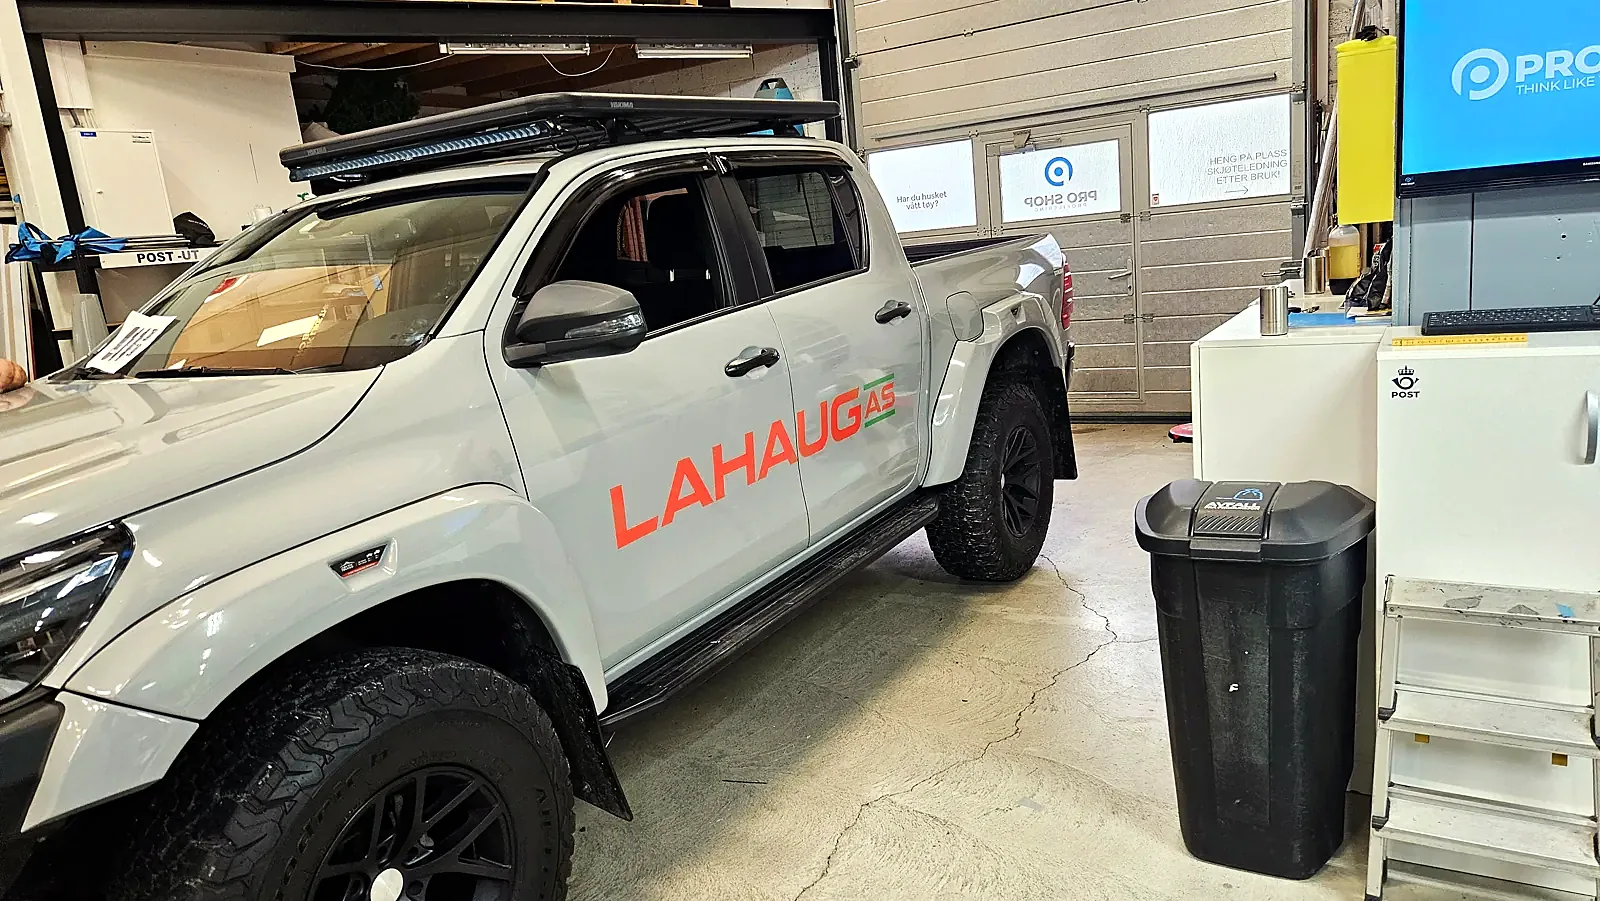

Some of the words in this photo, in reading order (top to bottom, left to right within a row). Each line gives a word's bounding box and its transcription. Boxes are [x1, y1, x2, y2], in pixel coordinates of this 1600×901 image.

[1515, 44, 1600, 83] PRO
[1516, 80, 1560, 95] THINK
[1563, 75, 1596, 90] LIKE
[1209, 154, 1237, 165] HENG
[1239, 151, 1253, 162] PÅ
[1255, 149, 1287, 160] PLASS
[1207, 160, 1288, 175] SKJØTELEDNING
[1216, 173, 1248, 185] ETTER
[1250, 170, 1281, 181] BRUK!
[921, 191, 947, 200] husket
[906, 201, 921, 210] vått
[922, 200, 939, 209] tøy?
[136, 251, 174, 263] POST
[177, 250, 200, 261] -UT
[1391, 391, 1420, 399] POST
[609, 386, 862, 550] LAHAUG
[864, 382, 896, 419] AS
